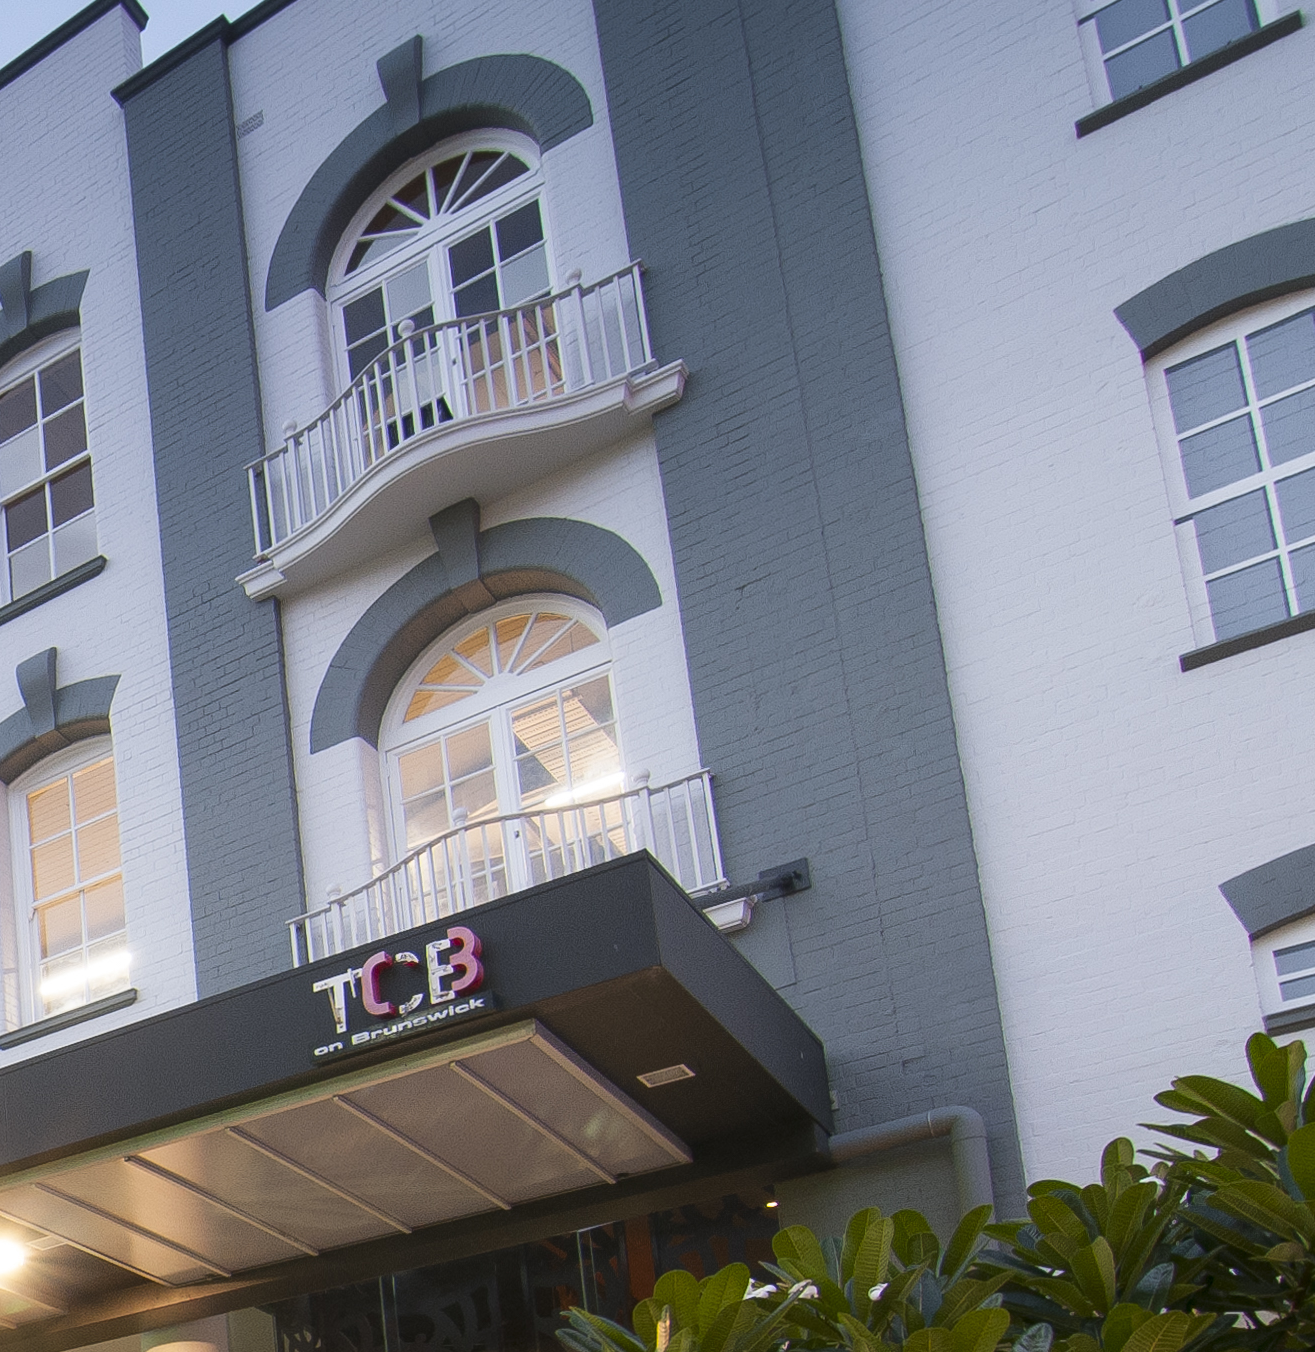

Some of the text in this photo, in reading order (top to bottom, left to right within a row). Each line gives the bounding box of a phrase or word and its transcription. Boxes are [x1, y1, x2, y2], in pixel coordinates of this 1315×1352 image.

[313, 926, 484, 1034] TCB
[314, 997, 485, 1057] on Brunswick
